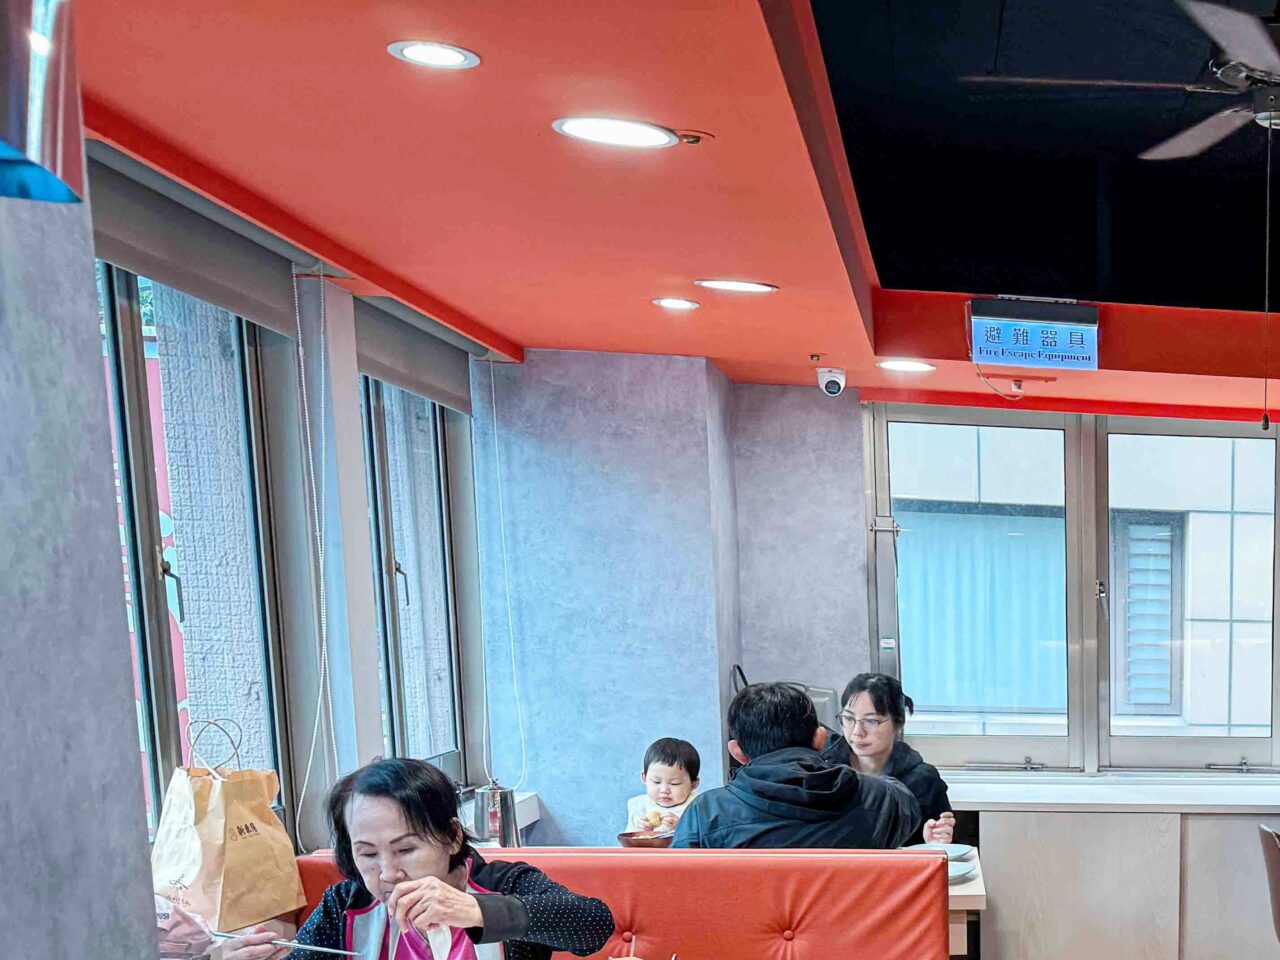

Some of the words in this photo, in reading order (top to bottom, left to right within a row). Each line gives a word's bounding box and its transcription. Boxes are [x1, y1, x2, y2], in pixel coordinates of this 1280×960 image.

[983, 325, 1087, 349] 避難器具
[979, 346, 999, 357] Fire
[1001, 347, 1036, 360] Escape
[1037, 350, 1092, 363] Equipment
